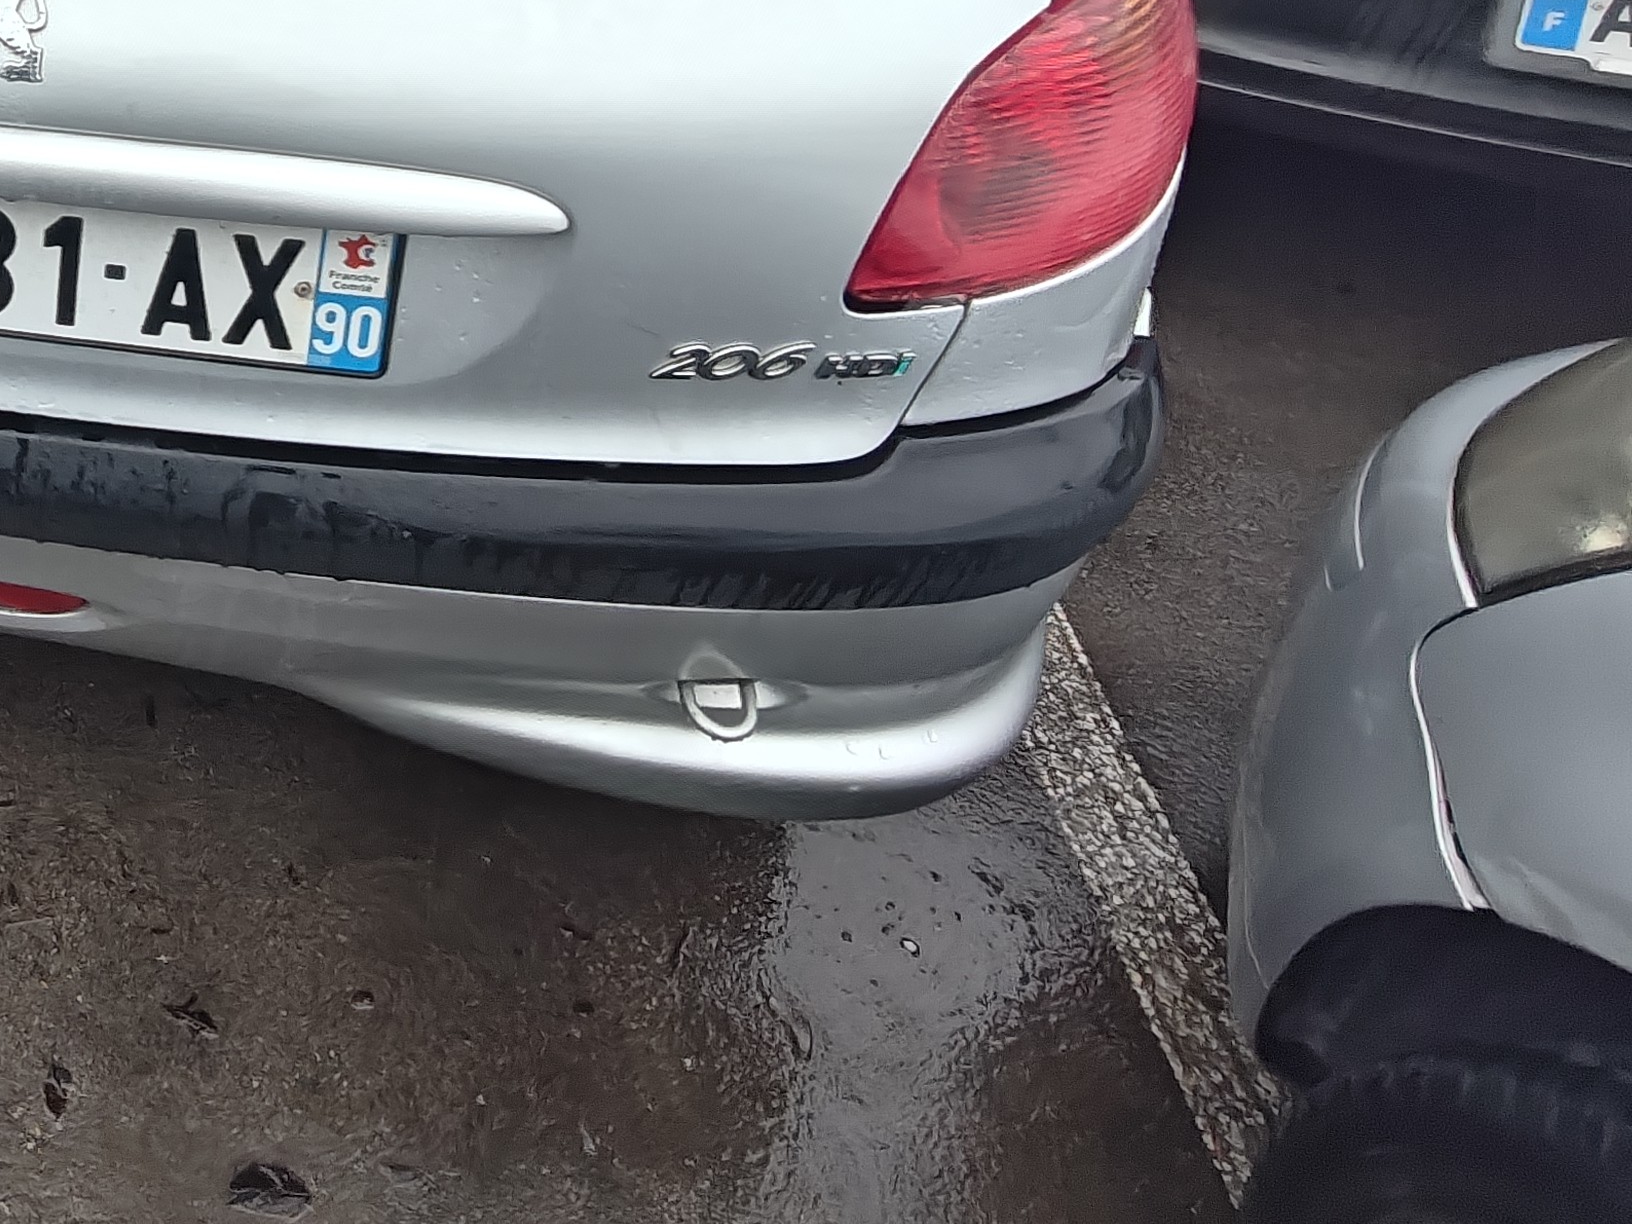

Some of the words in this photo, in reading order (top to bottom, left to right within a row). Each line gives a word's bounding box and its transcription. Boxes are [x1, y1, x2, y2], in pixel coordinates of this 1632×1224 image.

[1542, 11, 1565, 32] F
[312, 302, 382, 358] 90
[648, 340, 817, 381] 206
